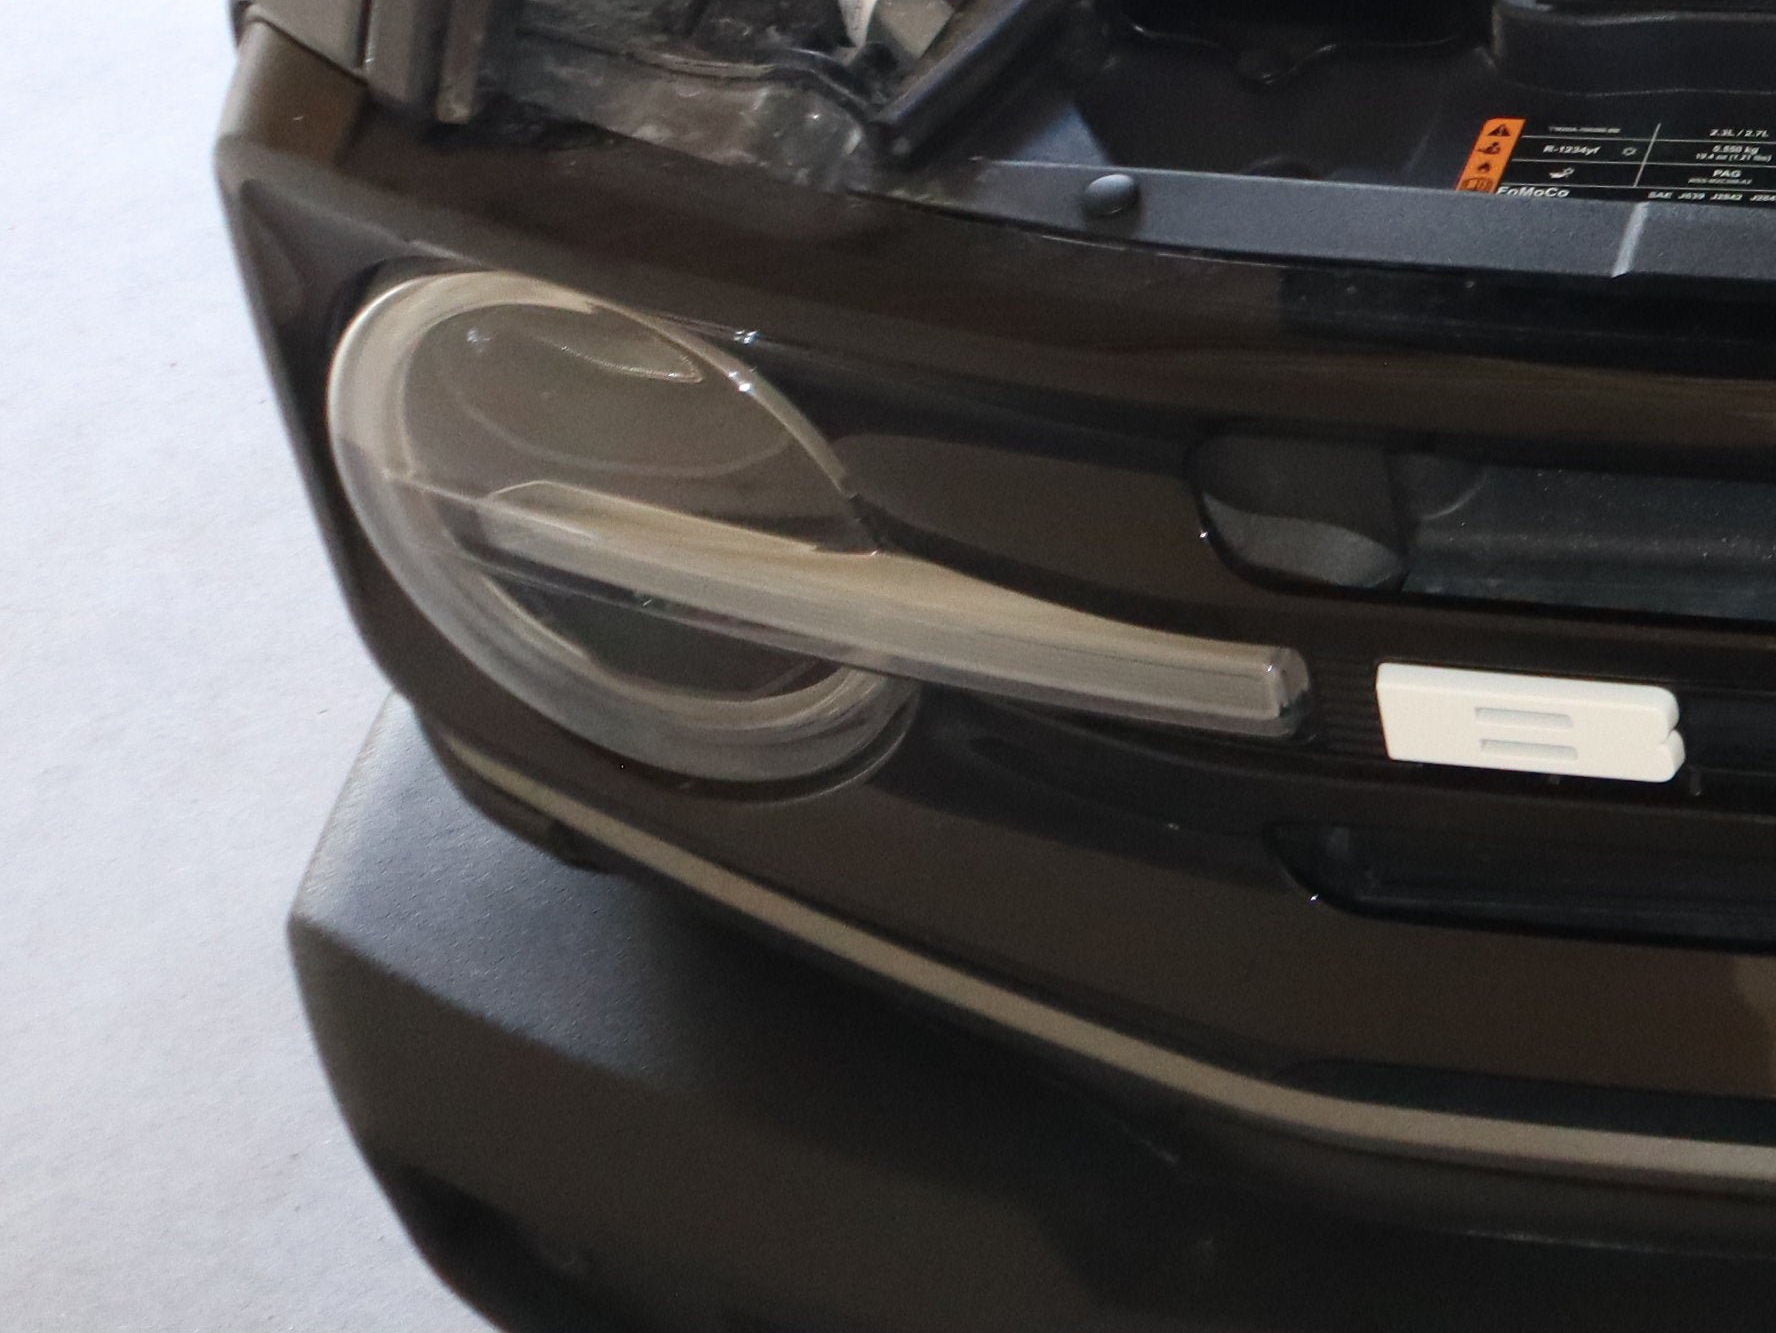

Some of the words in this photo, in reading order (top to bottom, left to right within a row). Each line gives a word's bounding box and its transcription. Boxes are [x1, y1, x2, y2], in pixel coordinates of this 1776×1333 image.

[1709, 128, 1735, 138] 2.3L
[1744, 129, 1770, 138] 2.7L
[1543, 144, 1601, 156] R-1234yf
[1744, 146, 1761, 155] kg
[1712, 169, 1743, 178] PAG
[1496, 185, 1571, 198] FoMoCo
